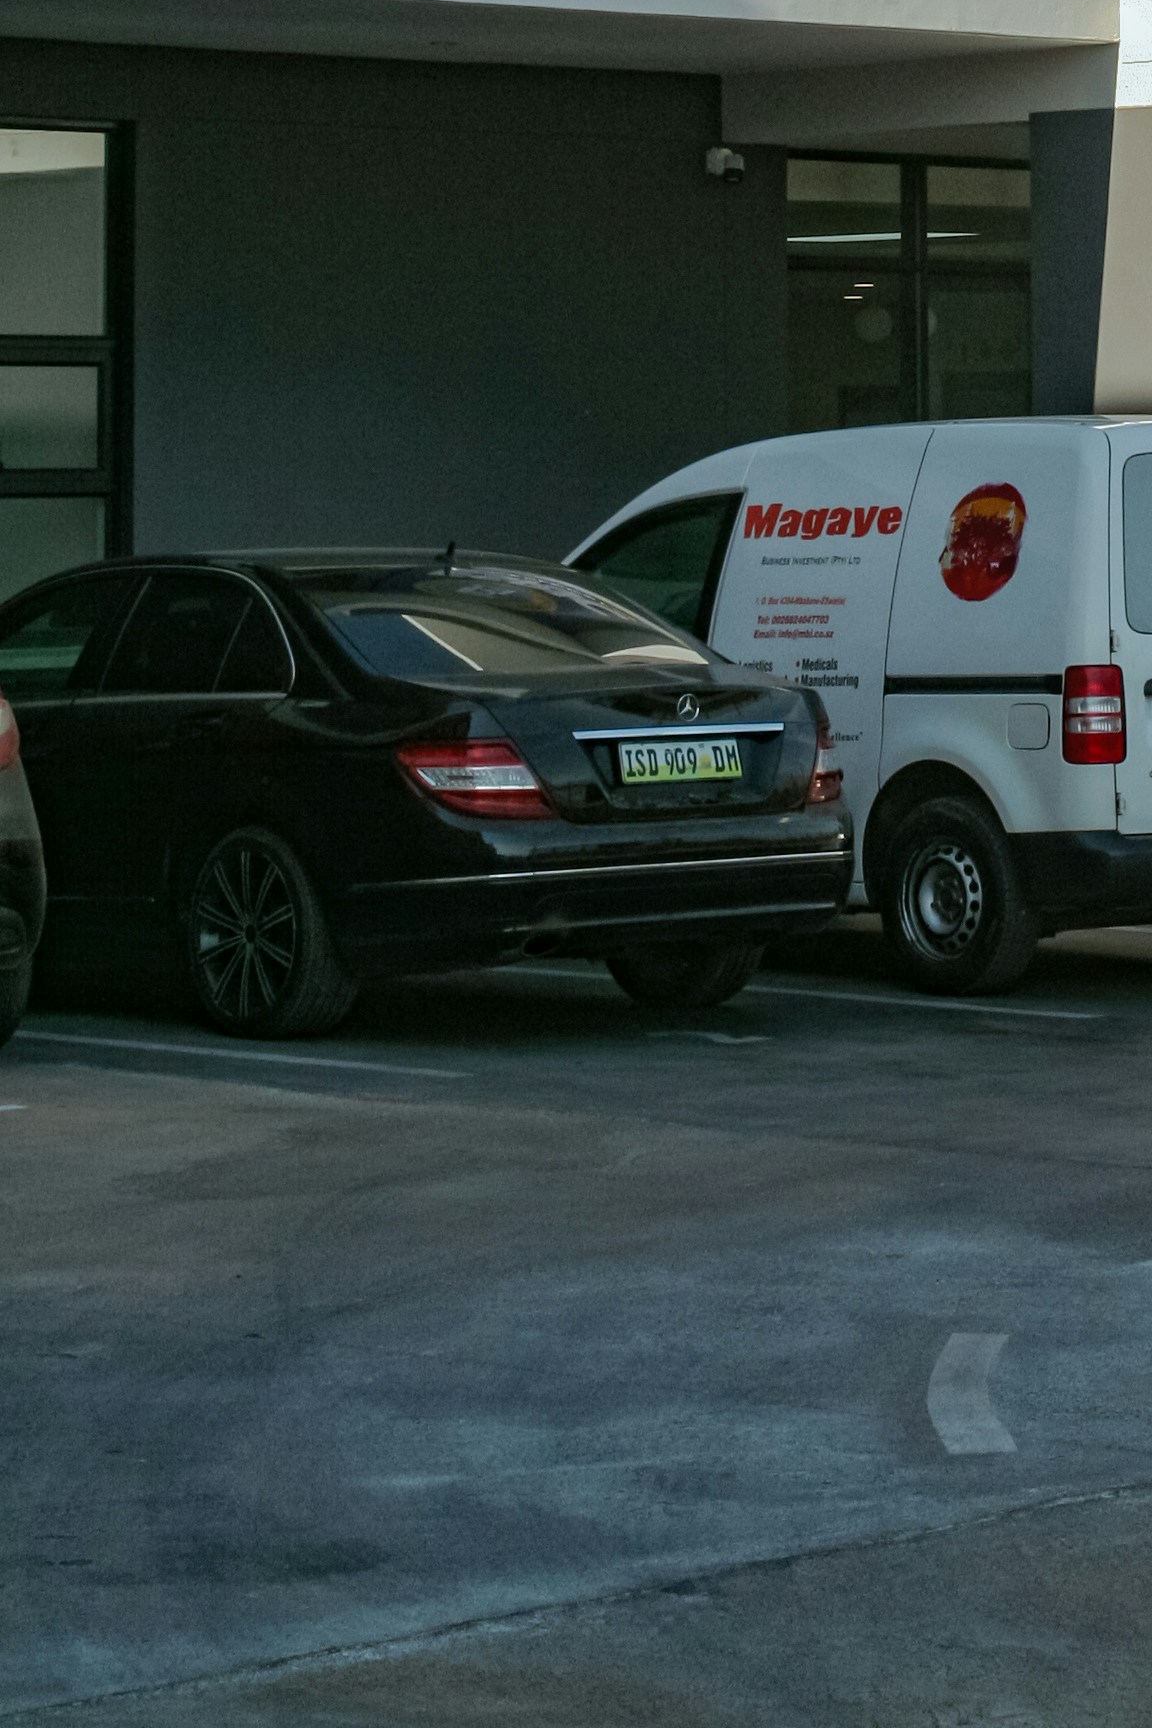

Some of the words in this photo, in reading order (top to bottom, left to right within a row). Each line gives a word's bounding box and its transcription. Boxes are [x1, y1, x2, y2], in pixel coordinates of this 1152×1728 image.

[743, 503, 903, 540] Magaye
[801, 658, 838, 672] Medicals
[800, 674, 860, 689] Manufacturing
[625, 748, 659, 778] ISD
[664, 747, 698, 776] 909
[711, 745, 739, 773] DM
